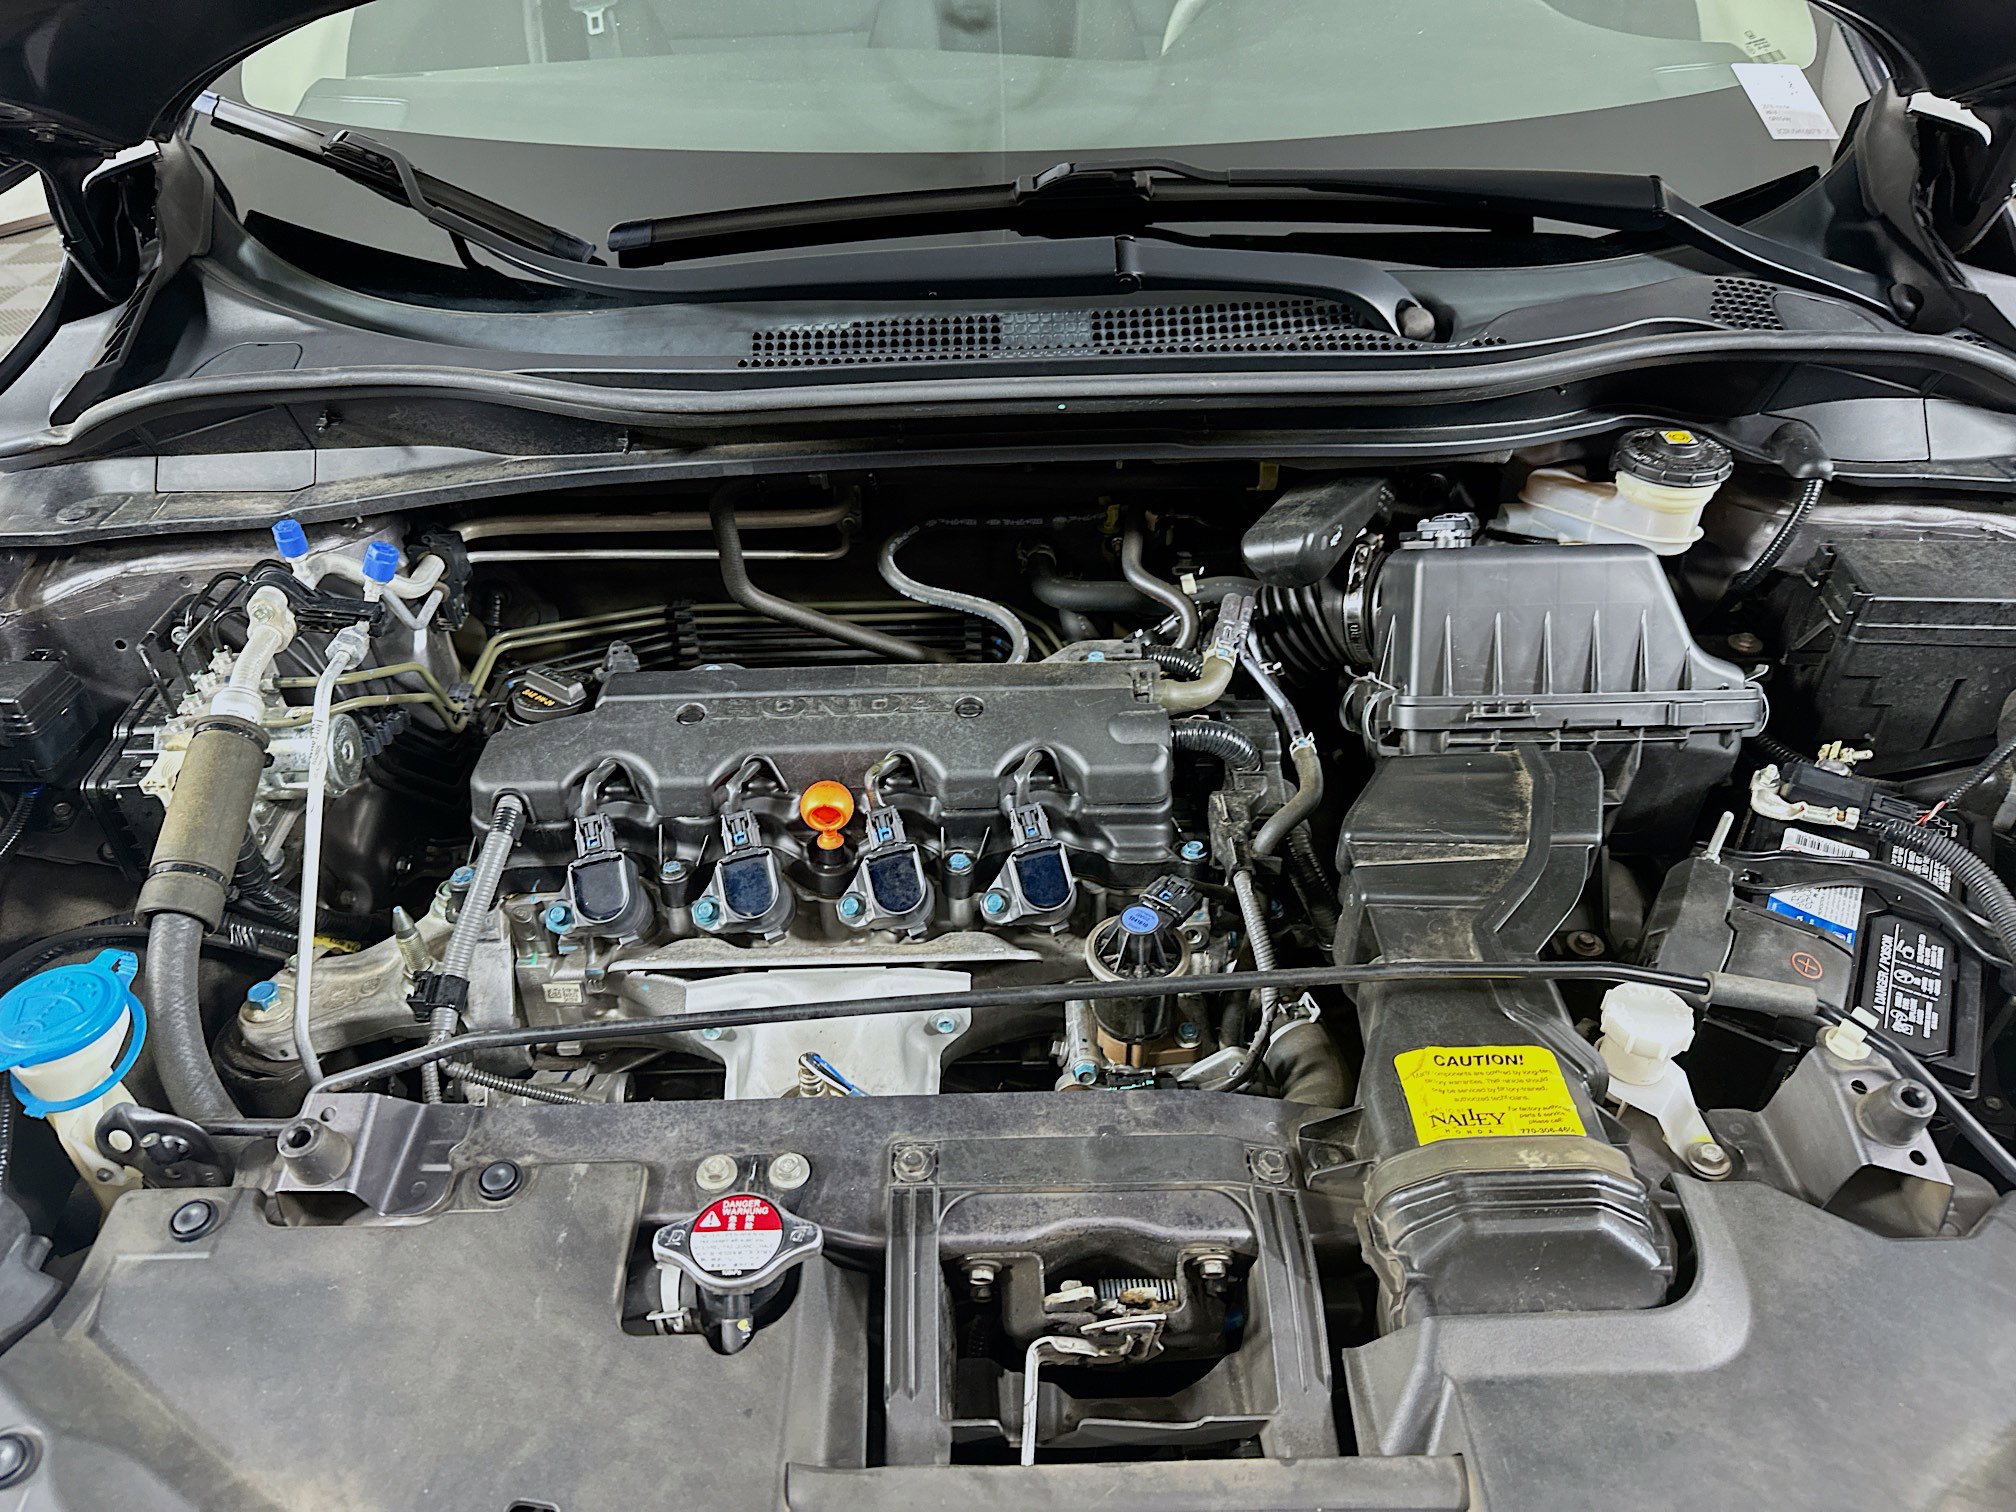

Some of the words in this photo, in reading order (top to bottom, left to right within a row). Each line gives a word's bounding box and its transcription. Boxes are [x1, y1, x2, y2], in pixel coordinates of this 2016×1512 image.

[709, 695, 951, 719] HONDA
[1880, 934, 1893, 965] POISON
[1874, 970, 1889, 1005] DANGER
[1433, 1054, 1524, 1067] CAUTION!
[1429, 1108, 1506, 1129] NALLEY
[722, 1200, 761, 1208] DANGER
[722, 1207, 769, 1215] WARNUNG
